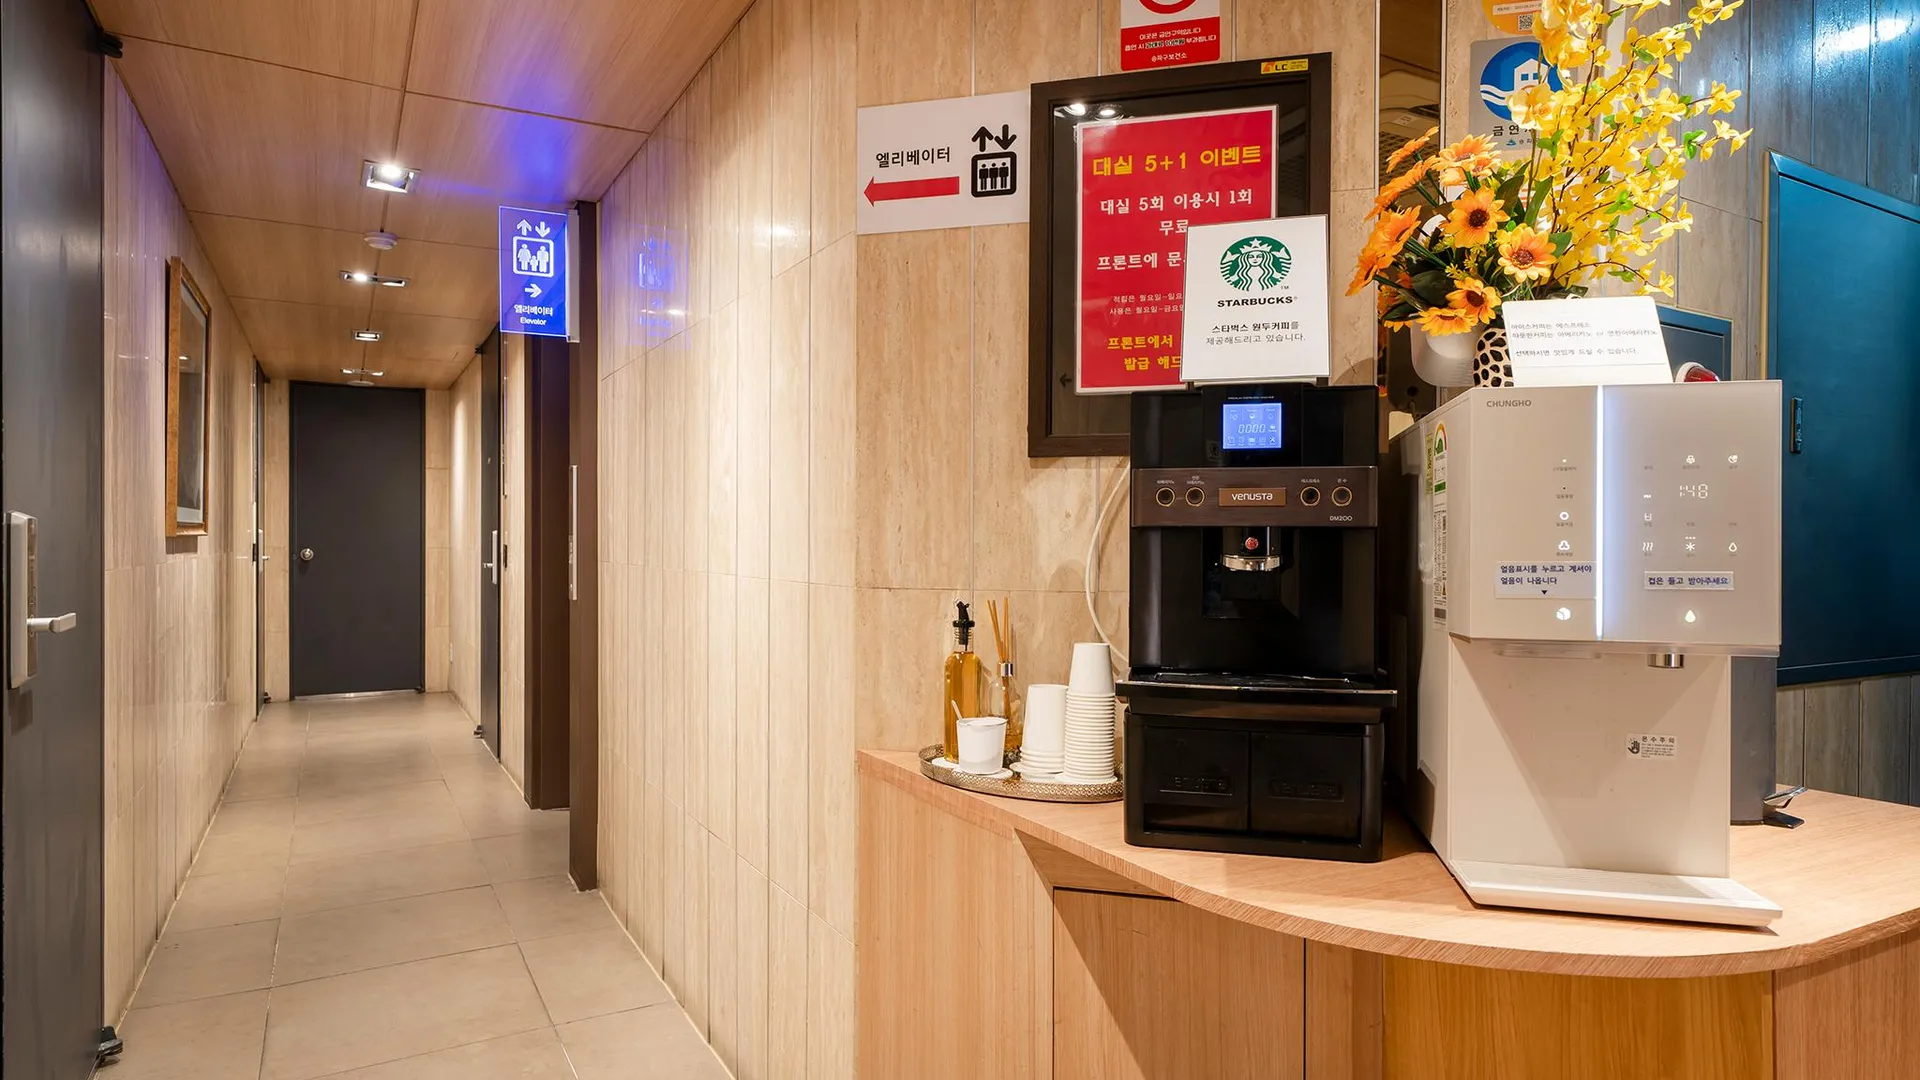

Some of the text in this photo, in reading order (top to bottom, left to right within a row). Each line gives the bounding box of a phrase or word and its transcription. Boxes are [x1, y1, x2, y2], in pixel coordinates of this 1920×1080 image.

[876, 146, 950, 168] 엘리베이터
[1092, 145, 1261, 176] 대실 5+1 이벤트
[1100, 188, 1253, 215] 대실 5회 이용시 1회
[1097, 252, 1158, 271] 프론트에
[513, 304, 553, 317] 엘리베이터
[520, 316, 547, 326] Elevator
[1252, 321, 1299, 332] 원두커피를
[1107, 335, 1173, 350] 프론트에서
[1124, 357, 1150, 371] 발급
